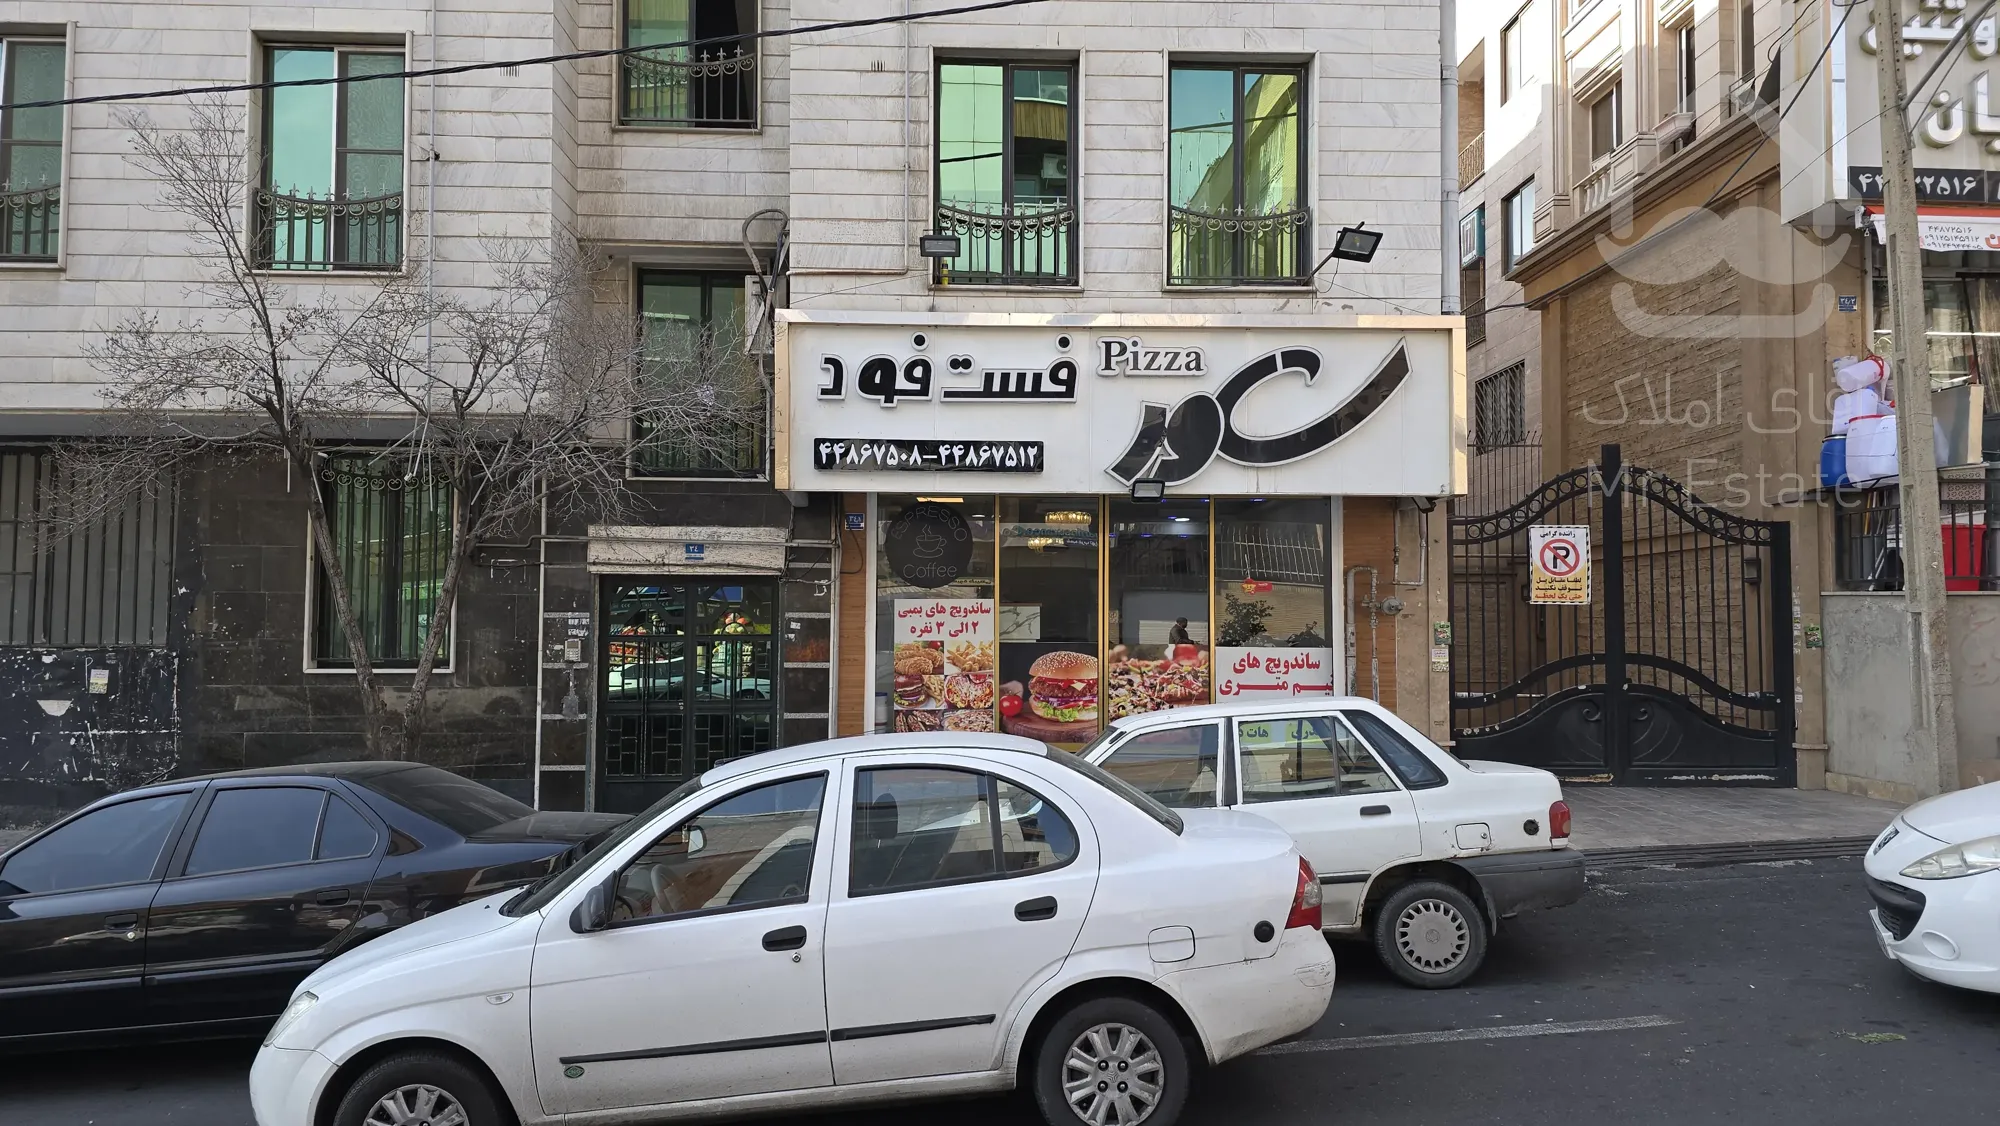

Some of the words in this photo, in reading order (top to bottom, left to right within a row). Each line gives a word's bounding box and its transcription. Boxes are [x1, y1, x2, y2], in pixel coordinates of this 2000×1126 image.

[1100, 339, 1204, 372] Pizza
[820, 334, 933, 404] فود
[891, 504, 968, 541] ESPRESSO
[1540, 530, 1557, 538] گرامی
[1558, 530, 1576, 538] راننده
[903, 562, 957, 578] Coffee
[898, 604, 922, 618] بمبی
[925, 602, 947, 618] های
[949, 601, 991, 618] ساندویچ
[910, 621, 932, 638] نفره
[936, 620, 945, 635] ۳
[948, 621, 968, 637] الی
[971, 621, 979, 635] ۲
[1233, 651, 1260, 674] های
[1265, 652, 1321, 675] ساندویچ
[1219, 676, 1289, 695] متری
[1247, 725, 1269, 738] هات
